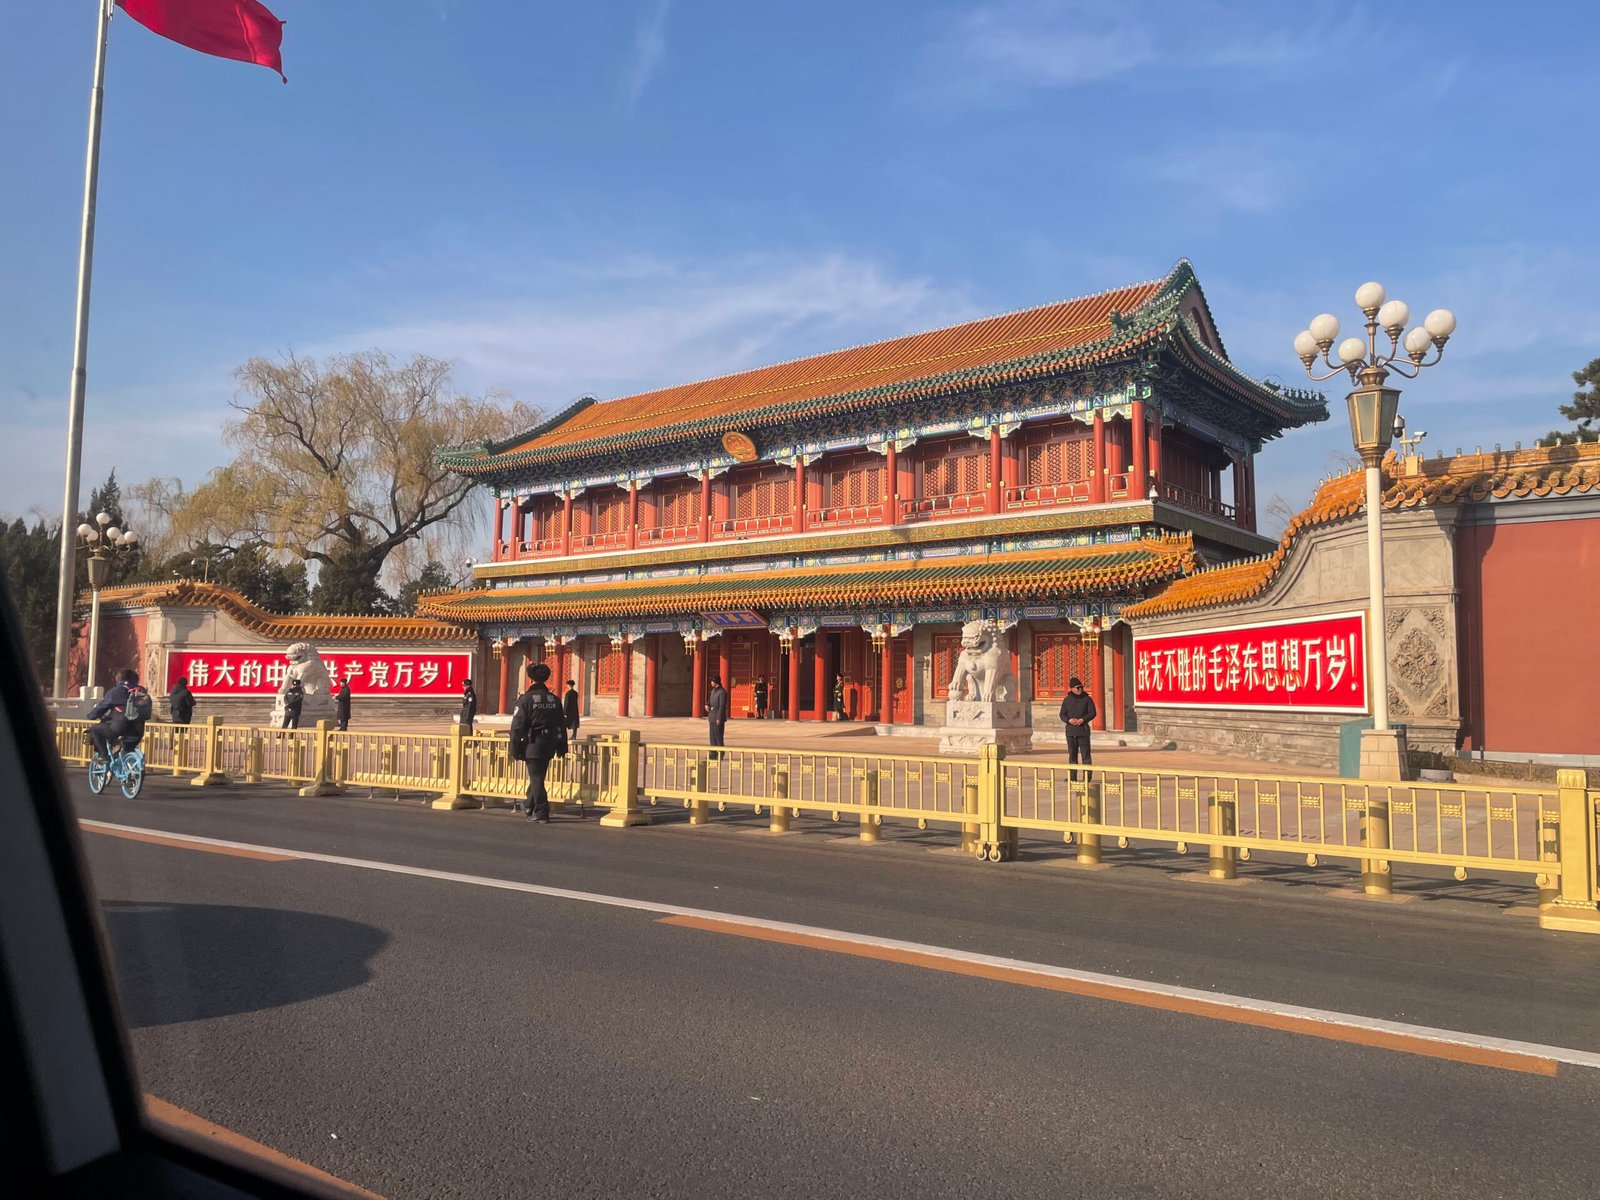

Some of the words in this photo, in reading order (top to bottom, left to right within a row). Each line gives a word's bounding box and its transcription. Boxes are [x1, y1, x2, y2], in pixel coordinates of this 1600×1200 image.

[187, 659, 453, 688] 伟大的中共产党万岁!
[1138, 633, 1358, 692] 战无不胜的毛泽东思想万岁!
